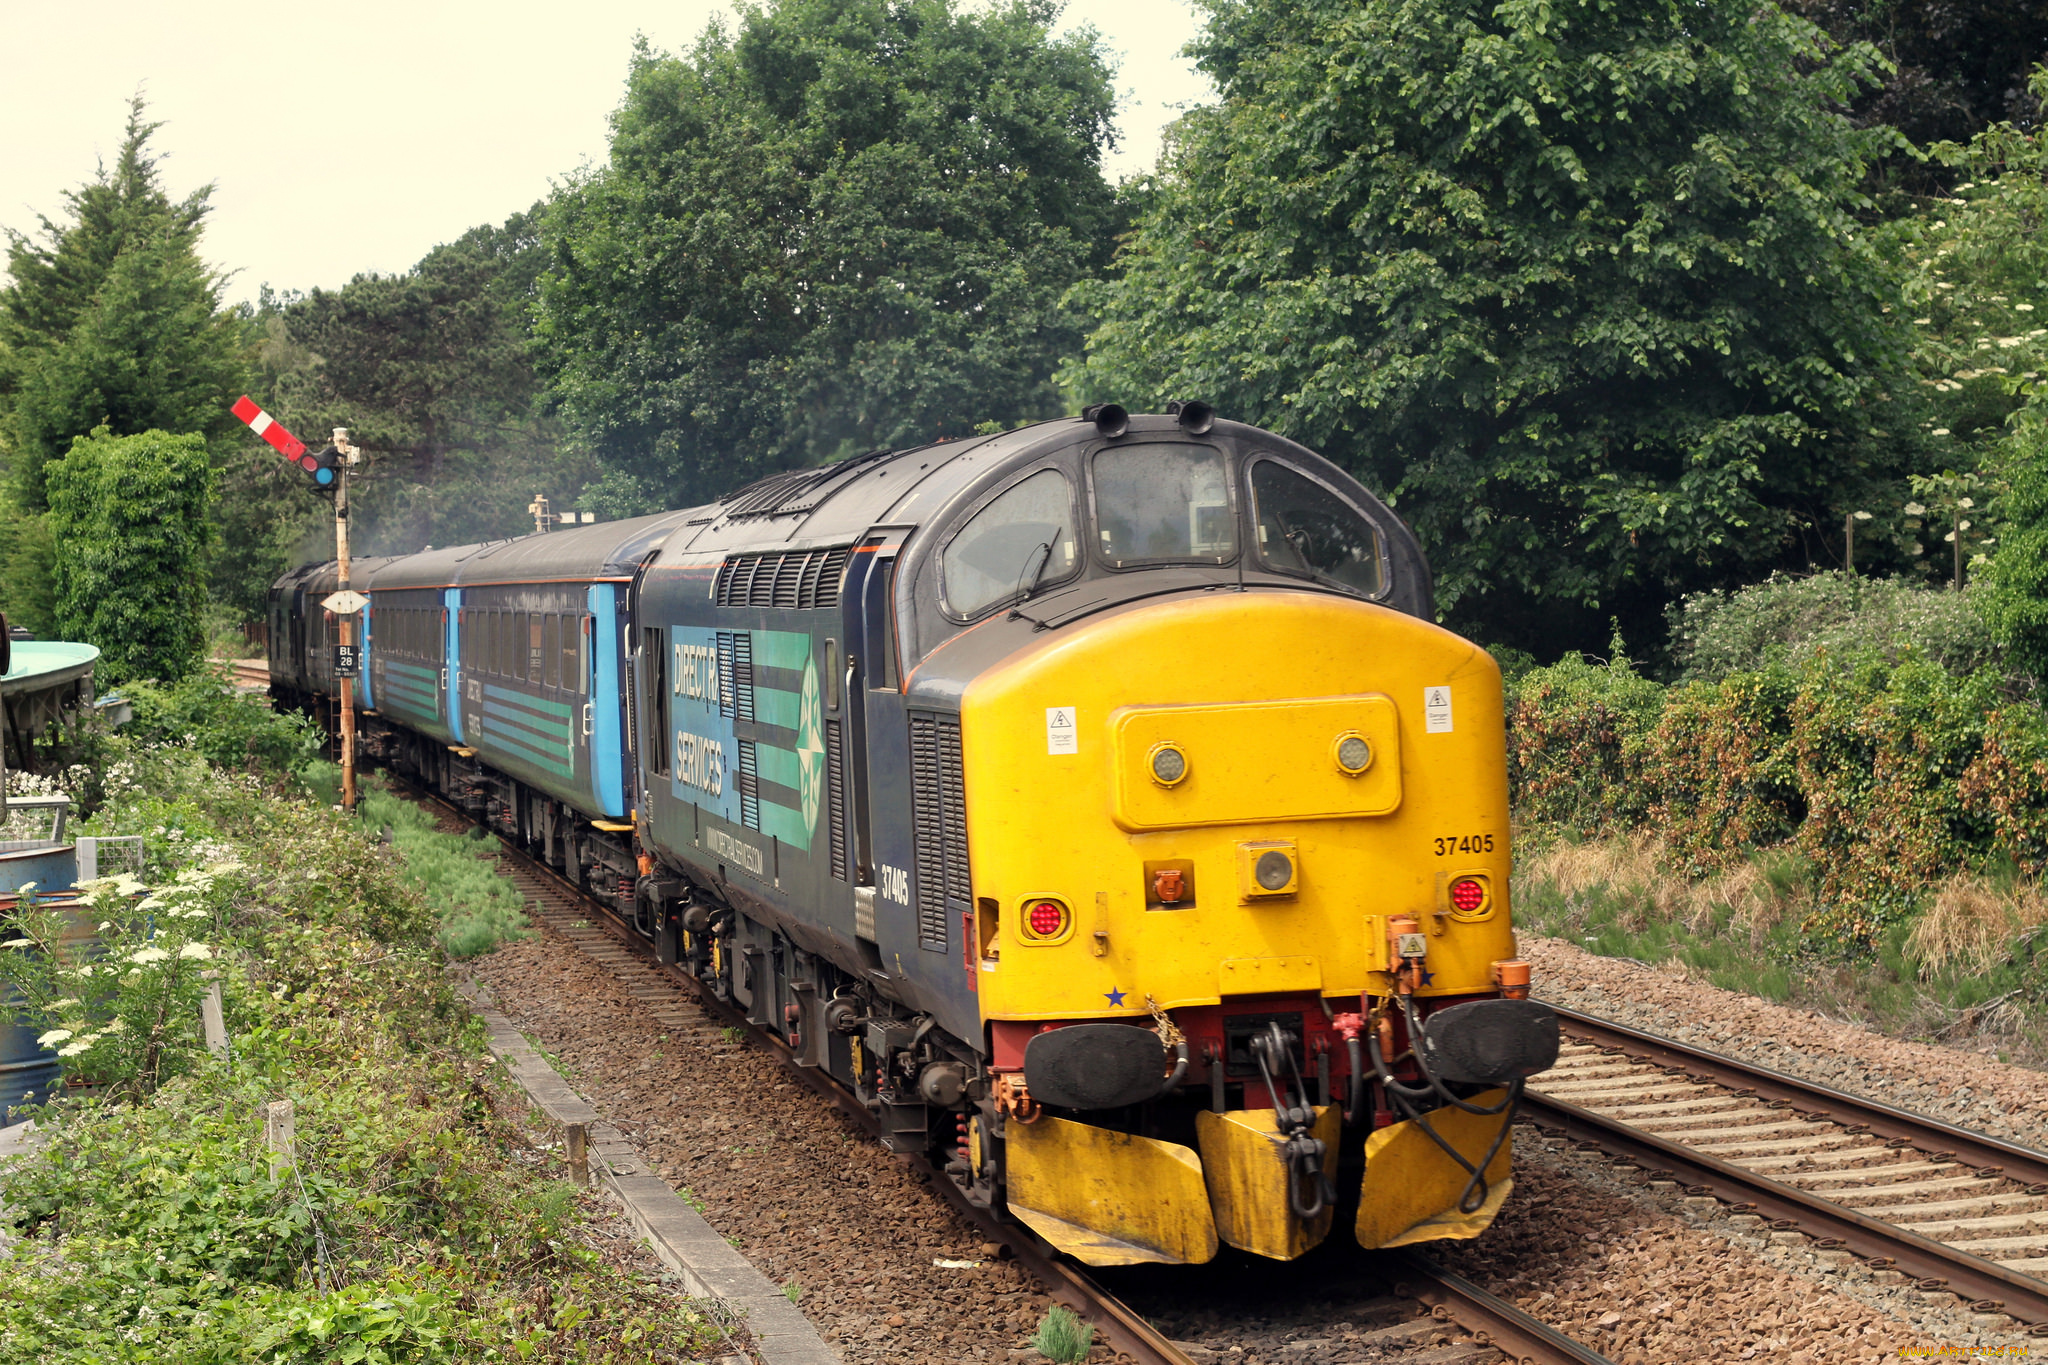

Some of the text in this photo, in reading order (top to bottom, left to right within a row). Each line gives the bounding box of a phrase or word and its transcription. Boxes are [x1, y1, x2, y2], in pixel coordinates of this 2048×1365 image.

[339, 646, 354, 656] BL
[340, 656, 353, 666] 28
[674, 643, 707, 700] DIRECT
[676, 729, 722, 796] SERVICES
[1433, 834, 1494, 857] 37405
[881, 863, 909, 907] 37405
